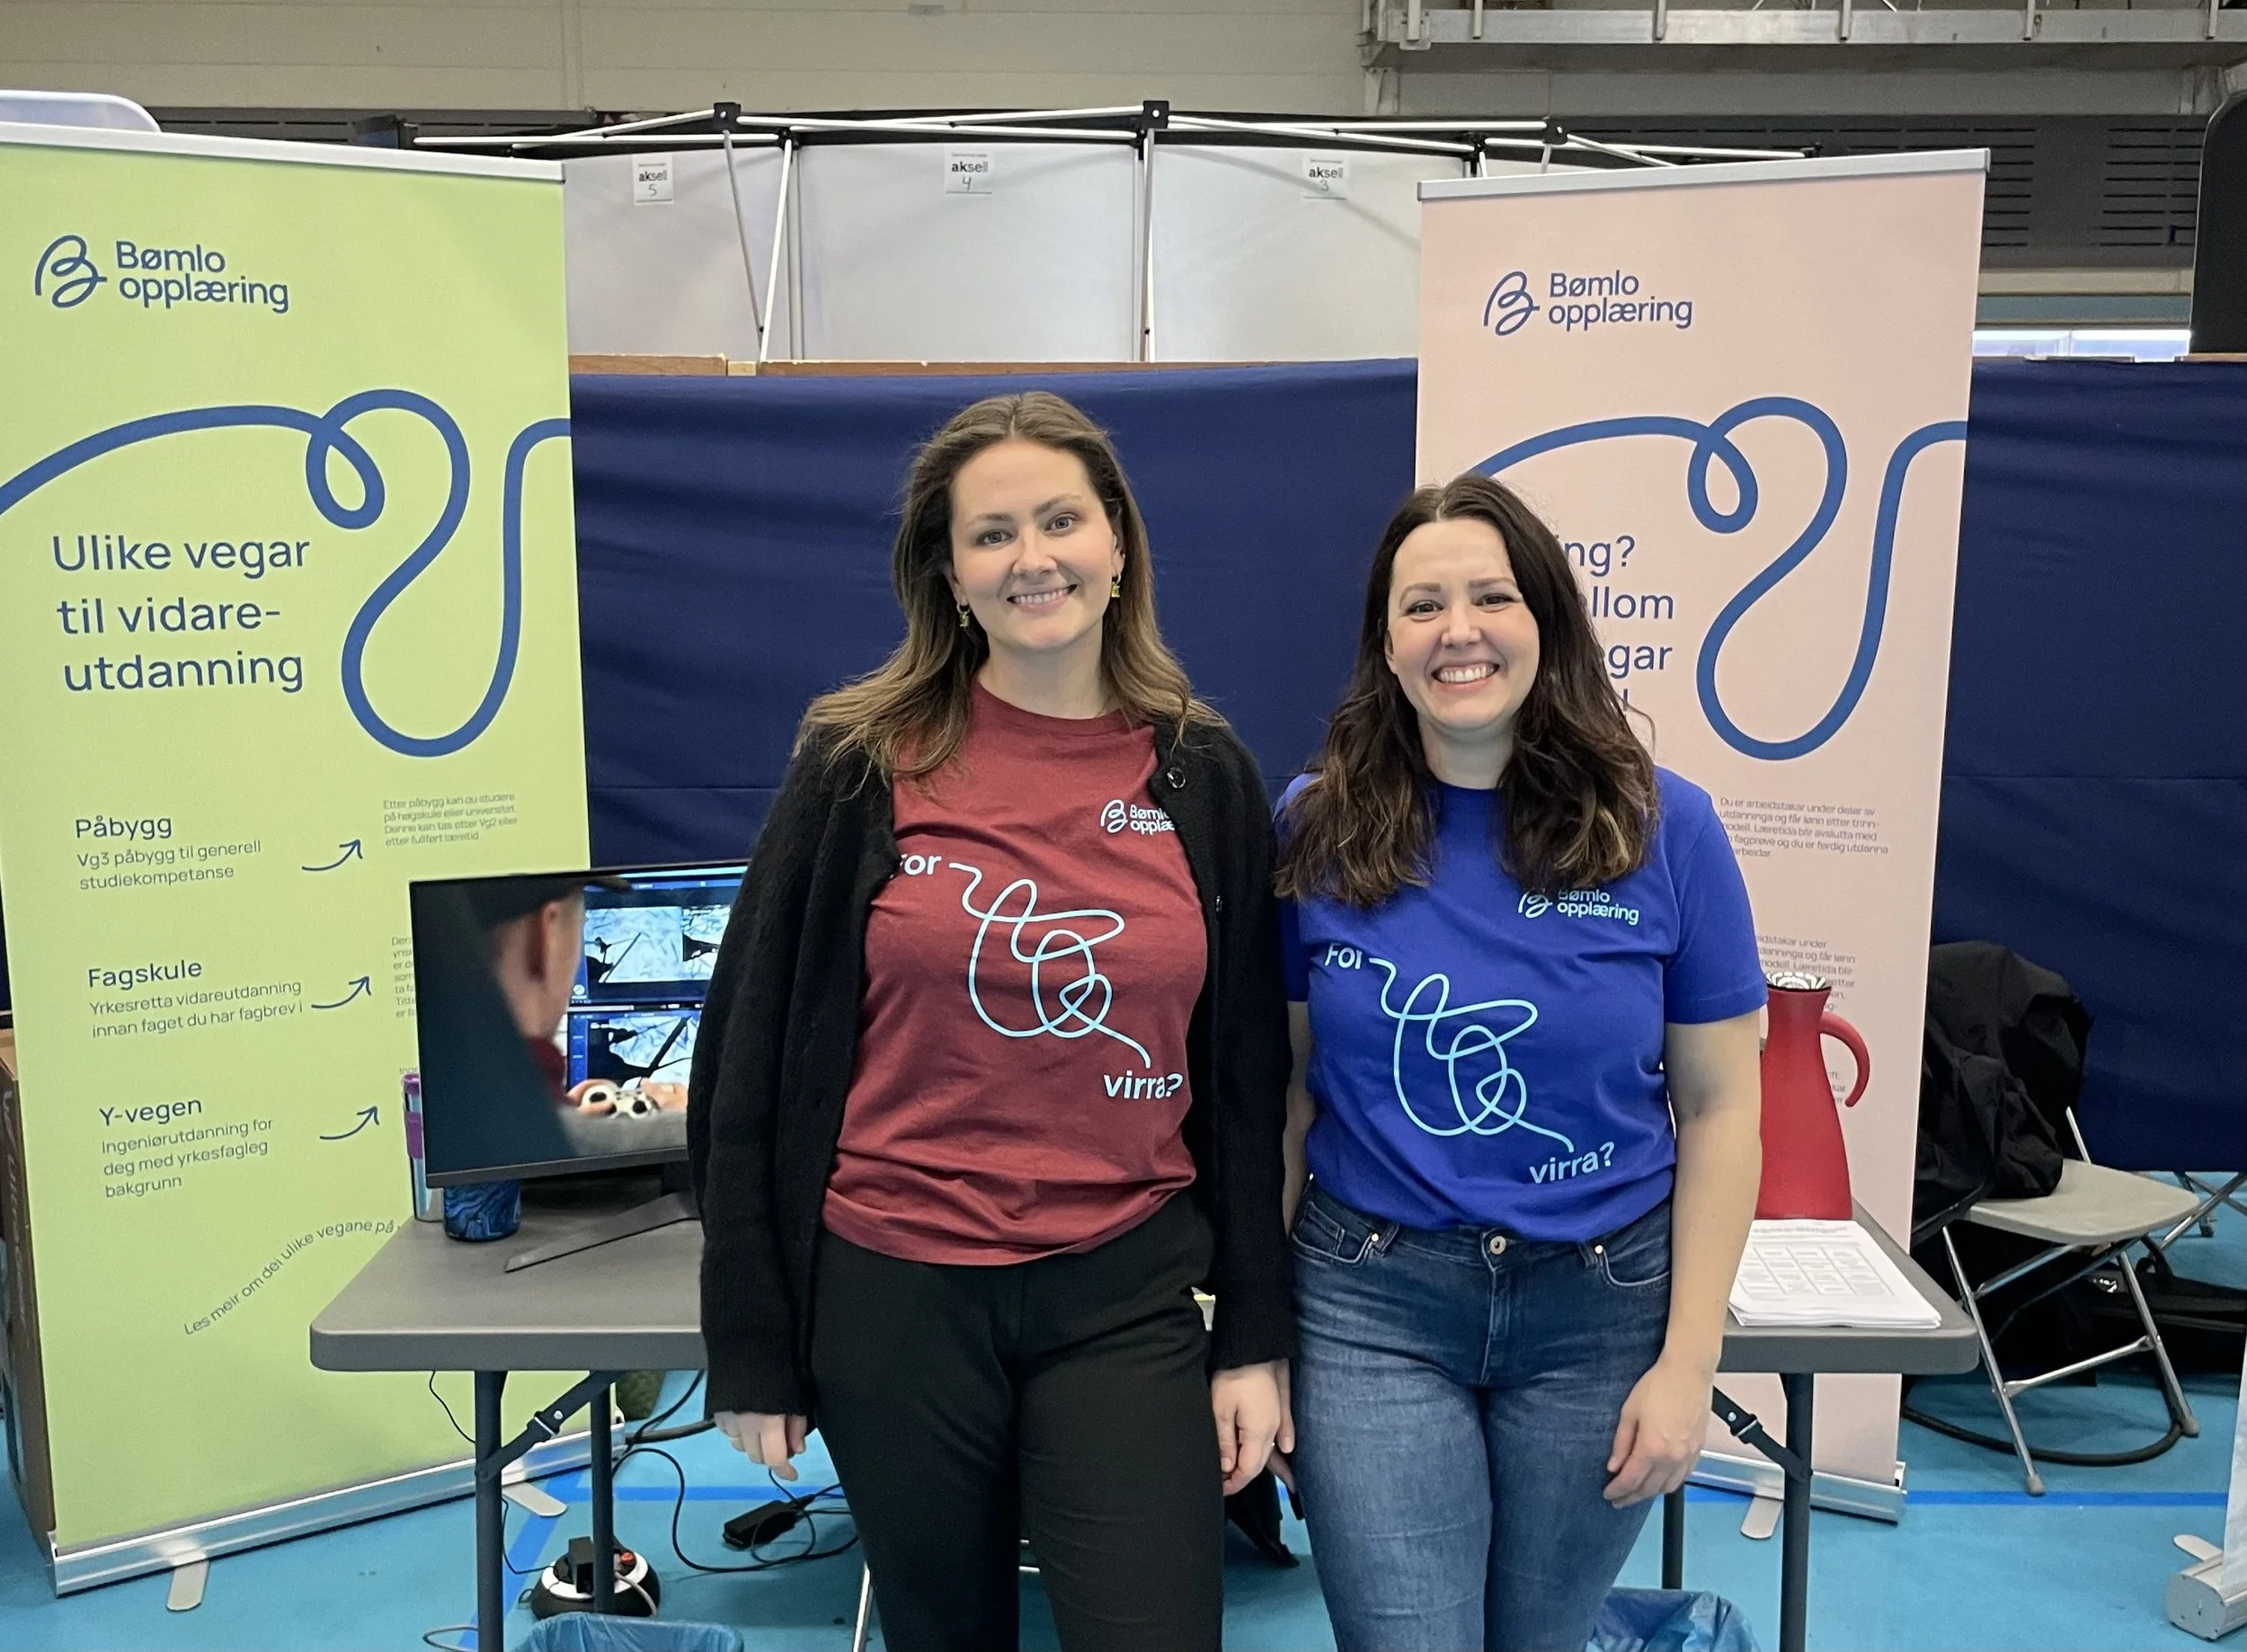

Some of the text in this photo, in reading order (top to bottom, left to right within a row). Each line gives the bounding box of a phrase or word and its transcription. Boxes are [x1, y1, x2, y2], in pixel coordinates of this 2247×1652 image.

[648, 183, 658, 197] 5
[962, 176, 972, 191] 4
[1320, 179, 1329, 191] 3
[116, 240, 226, 273] Bømlo
[118, 274, 289, 314] opplæring
[1549, 270, 1639, 298] Bømlo
[1548, 295, 1693, 332] opplæring
[52, 535, 310, 580] Ulike vegar
[1562, 535, 1635, 577] ng?
[56, 595, 280, 635] til vidare-
[1591, 585, 1674, 620] llom
[63, 651, 304, 693] utdanning
[1607, 644, 1673, 679] gar
[75, 814, 173, 842] Påbygg
[1130, 819, 1176, 836] opplæ
[77, 839, 262, 870] Vg3 påbygg til generell
[79, 866, 235, 891] studiekompetanse
[1557, 901, 1639, 926] opplæring
[88, 959, 203, 990] Fagskule
[90, 981, 302, 1016] Yrkesretta vidareutdanning
[93, 1000, 303, 1038] innan faget du har fagbrev i
[1102, 1070, 1184, 1100] virra?
[99, 1098, 202, 1126] Y-vegen
[102, 1118, 273, 1156] Ingeniørutdanning for
[103, 1141, 269, 1177] deg med yrkesfagleg
[1530, 1141, 1616, 1184] virra?
[104, 1176, 183, 1198] bakgrunn
[183, 1219, 395, 1336] Les meir om dei ulike vegane på
